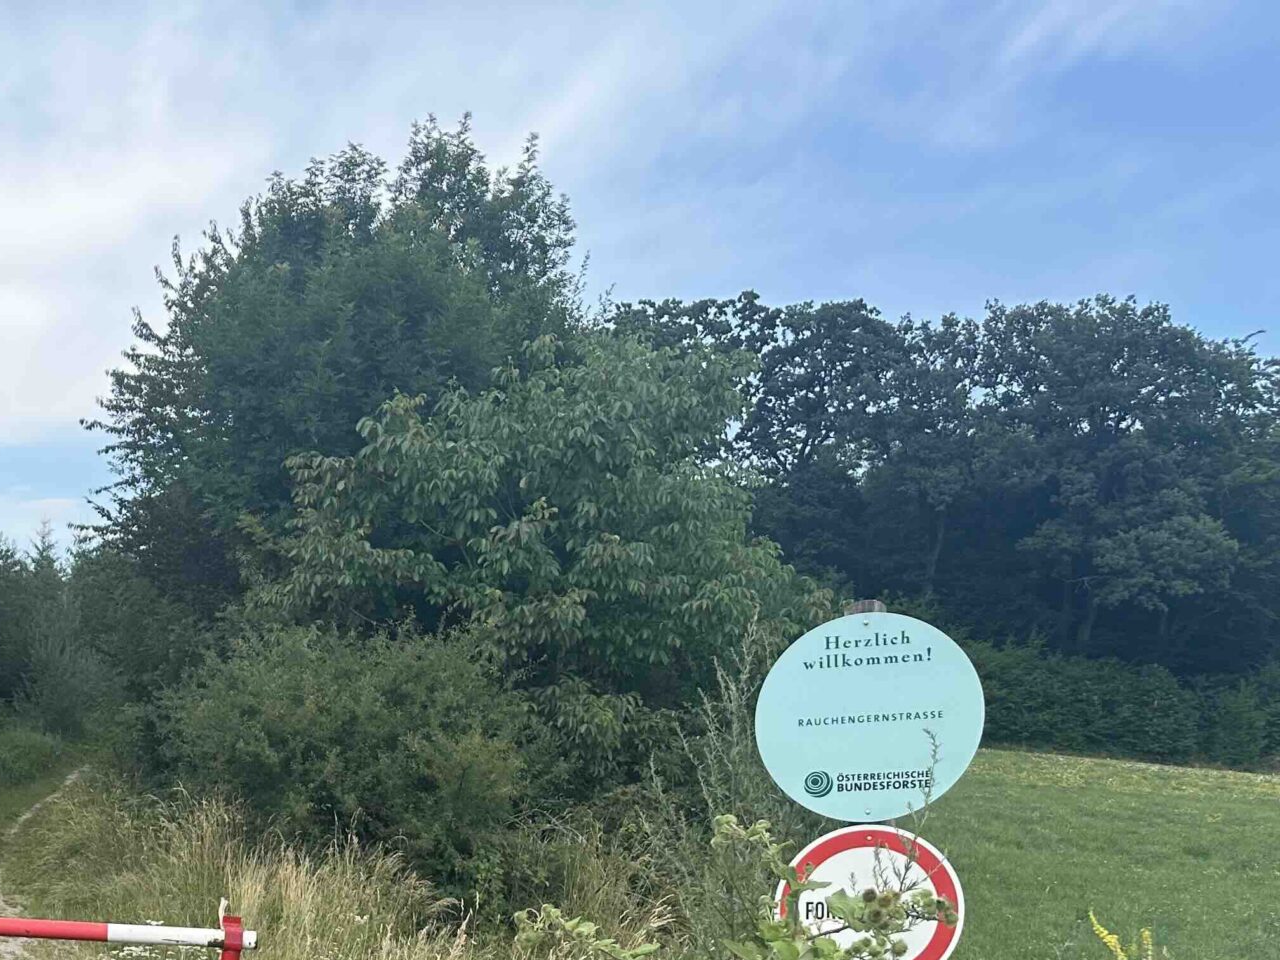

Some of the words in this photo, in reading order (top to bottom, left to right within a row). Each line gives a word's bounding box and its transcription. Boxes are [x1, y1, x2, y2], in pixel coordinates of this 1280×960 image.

[824, 630, 911, 650] Herzlich
[803, 647, 933, 670] willkommen!
[798, 710, 944, 727] RAUCHENGERNSTRASSE
[836, 770, 931, 783] ÖSTERREICHISCHE
[836, 779, 931, 793] BUNDESFORSTE
